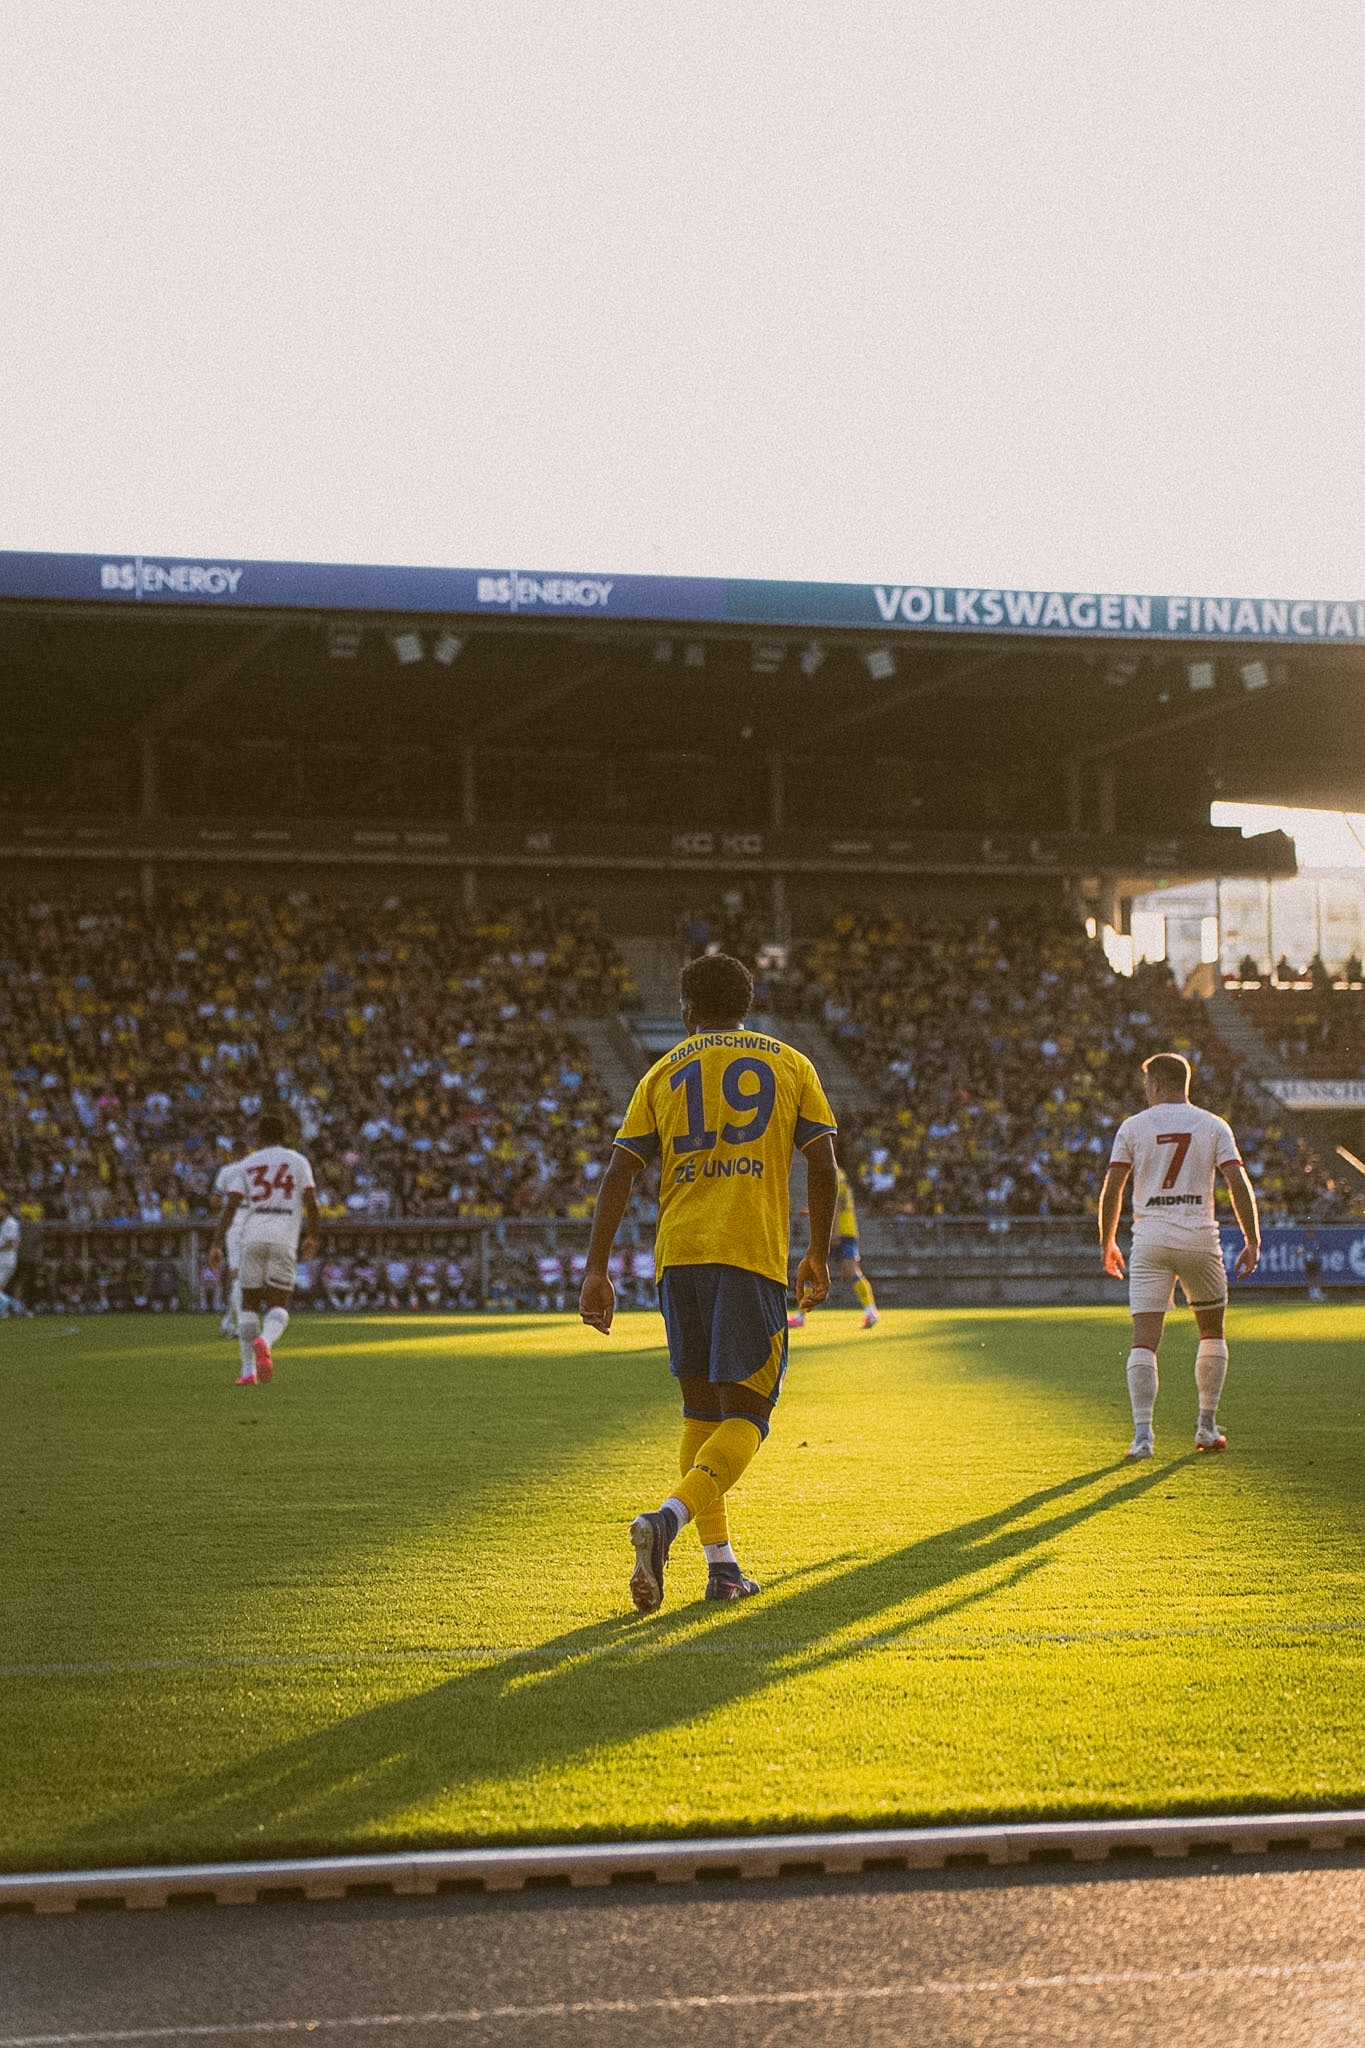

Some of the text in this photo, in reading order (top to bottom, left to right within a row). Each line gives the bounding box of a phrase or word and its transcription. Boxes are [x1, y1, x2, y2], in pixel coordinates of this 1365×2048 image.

[873, 586, 1152, 630] VOLKSWAGEN
[670, 1035, 781, 1063] BRAUNSCHWEIG
[669, 1057, 776, 1155] 19
[702, 1157, 764, 1179] UNIOR
[1156, 1132, 1192, 1189] 7
[246, 1162, 294, 1202] 34
